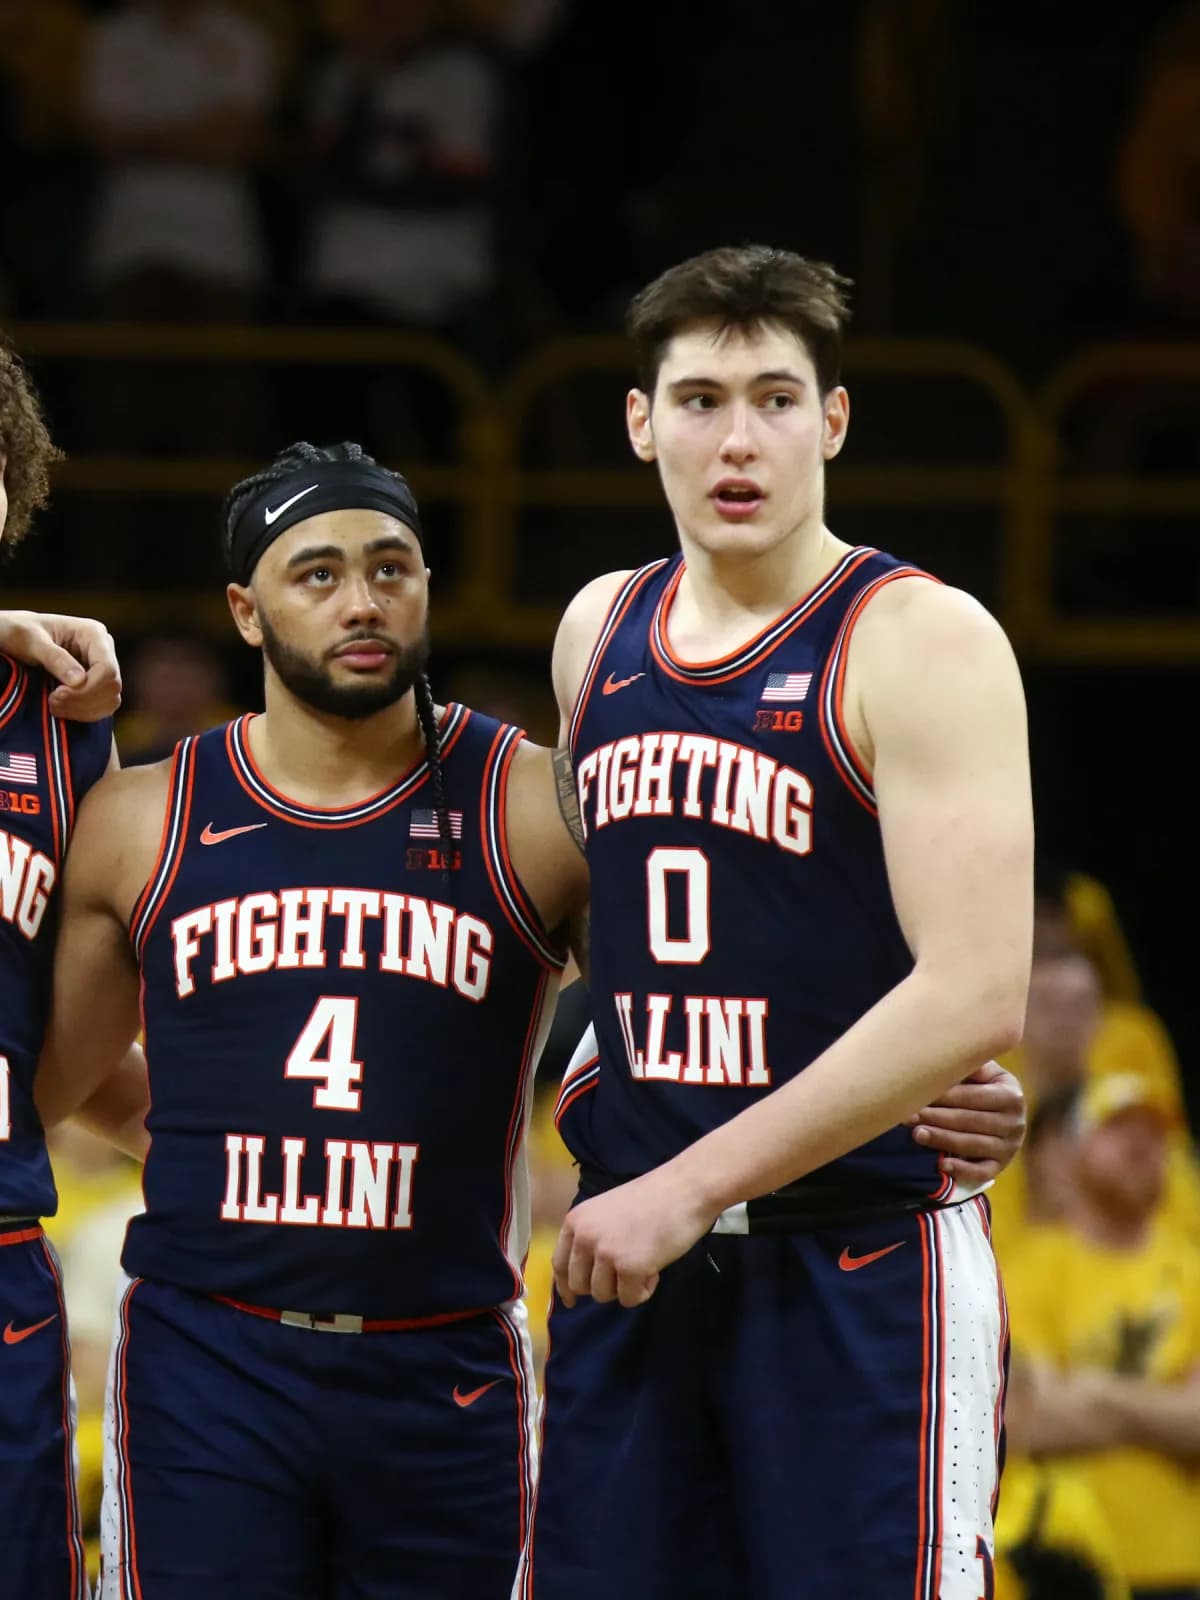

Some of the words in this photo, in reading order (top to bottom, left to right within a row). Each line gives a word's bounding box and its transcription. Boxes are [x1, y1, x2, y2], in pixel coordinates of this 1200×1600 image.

[577, 731, 815, 857] FIGHTING
[171, 887, 495, 1003] FIGHTING
[646, 846, 711, 965] 0
[284, 995, 364, 1112] 4
[220, 1133, 420, 1231] ILLINI
